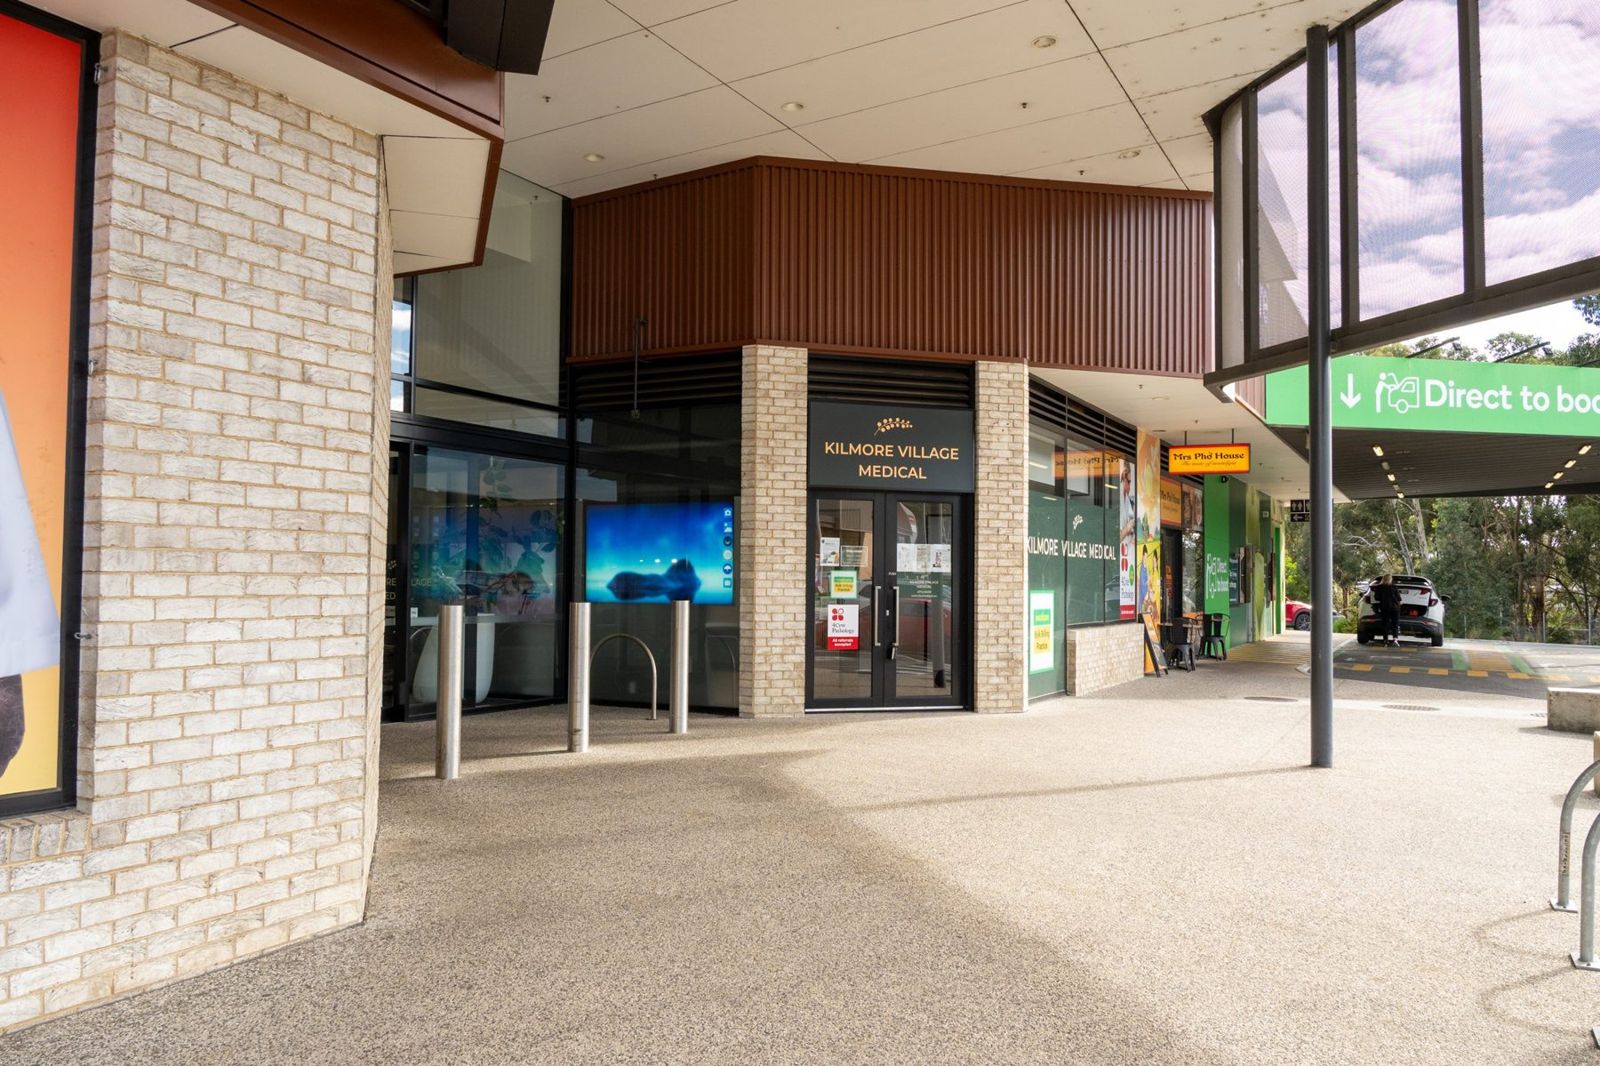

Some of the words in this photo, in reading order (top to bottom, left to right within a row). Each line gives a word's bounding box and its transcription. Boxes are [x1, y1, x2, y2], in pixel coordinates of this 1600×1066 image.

[1425, 379, 1512, 410] Direct
[1520, 385, 1550, 411] to
[825, 442, 894, 457] KILMORE
[898, 445, 959, 460] VILLAGE
[1215, 452, 1244, 460] House
[859, 465, 927, 479] MEDICAL
[1089, 543, 1116, 560] MEDICAL
